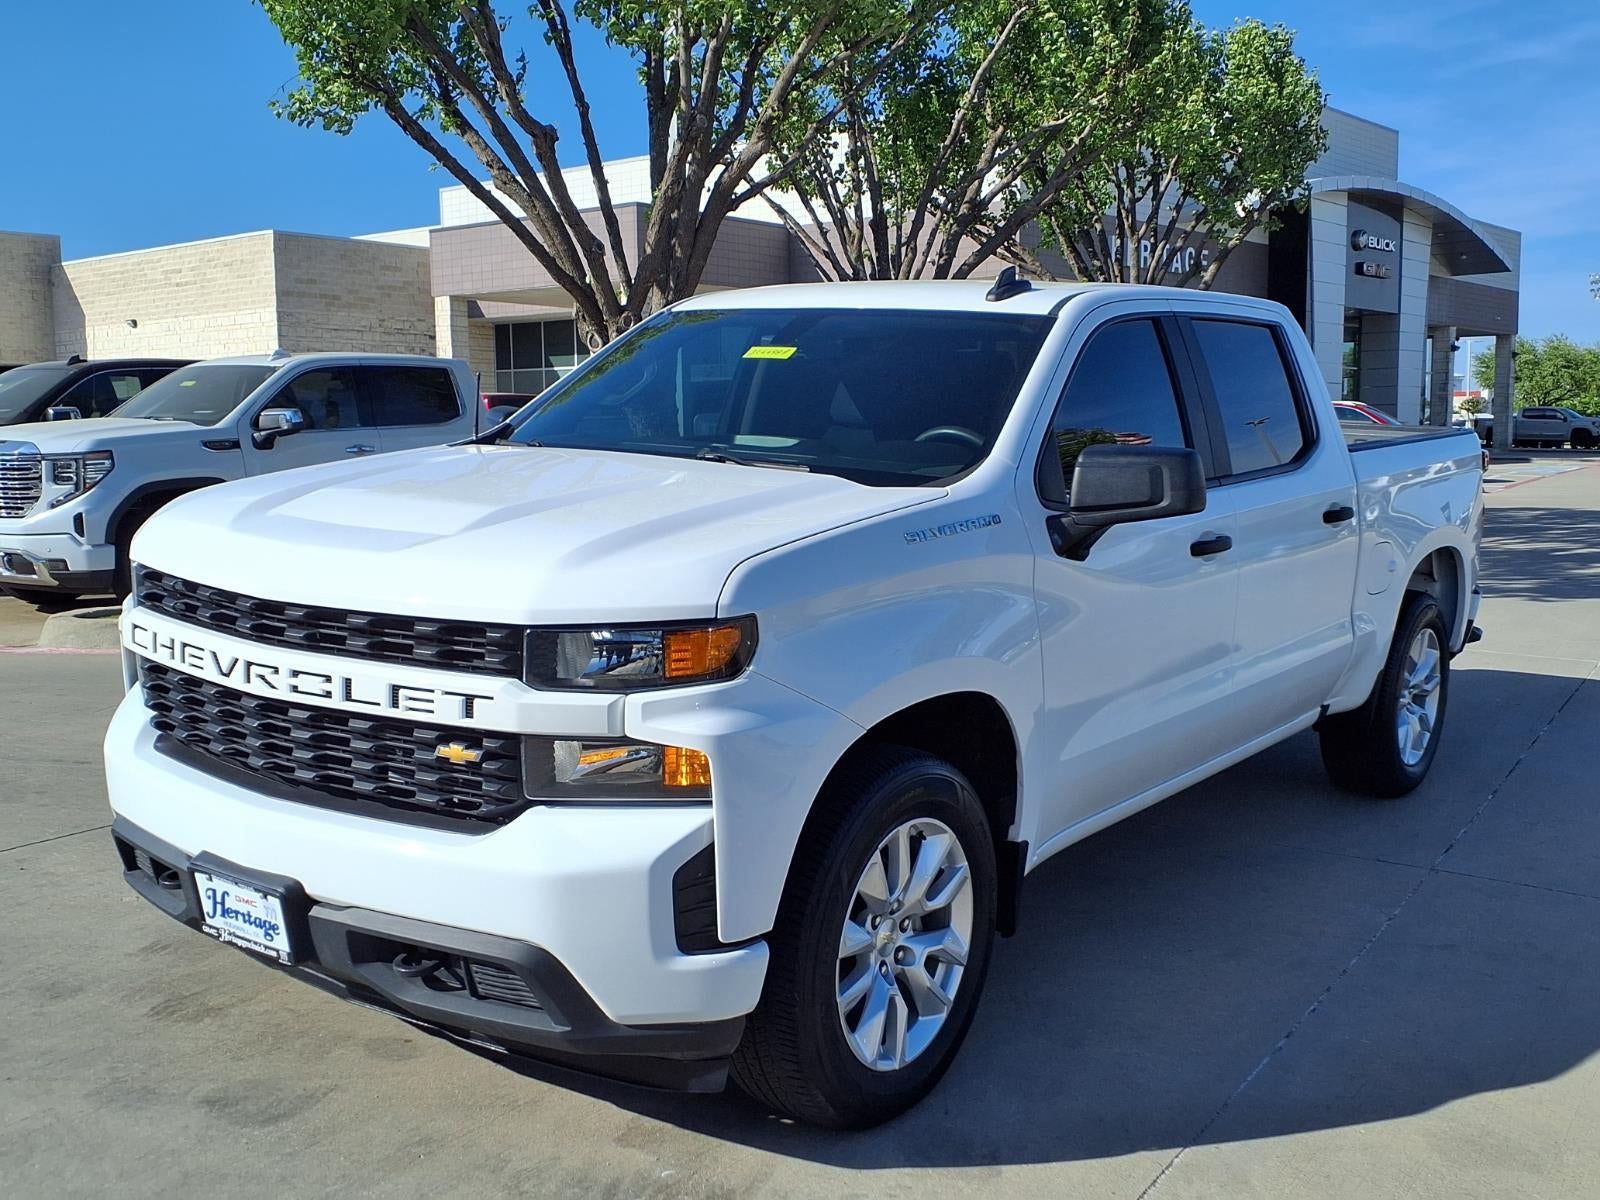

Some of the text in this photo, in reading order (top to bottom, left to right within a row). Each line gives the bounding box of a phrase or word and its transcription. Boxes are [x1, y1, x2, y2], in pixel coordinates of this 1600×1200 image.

[1368, 236, 1396, 252] BUICK
[1363, 262, 1393, 279] GMC
[903, 514, 1002, 544] SILVERADO
[131, 623, 494, 719] CHEVROLET
[234, 895, 258, 909] GMC
[205, 887, 281, 942] Heritage
